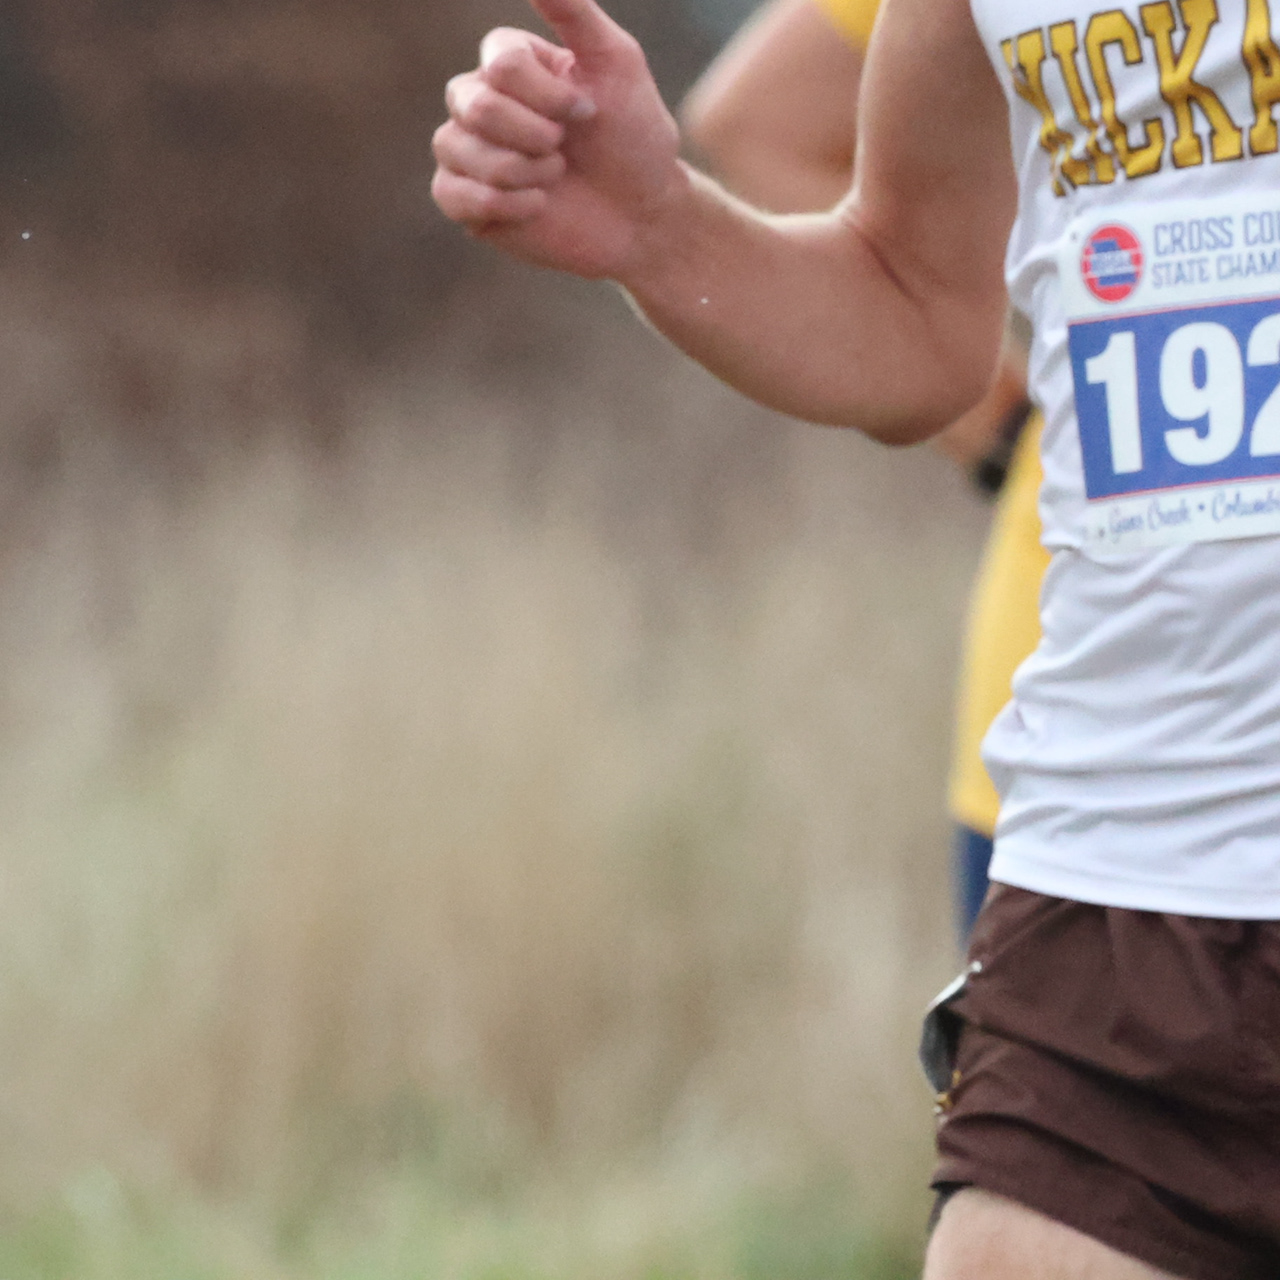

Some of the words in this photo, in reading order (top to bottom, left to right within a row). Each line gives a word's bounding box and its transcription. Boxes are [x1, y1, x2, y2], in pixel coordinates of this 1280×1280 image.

[1153, 216, 1234, 257] CROSS
[1243, 209, 1280, 248] CO
[1152, 257, 1210, 290] STATE
